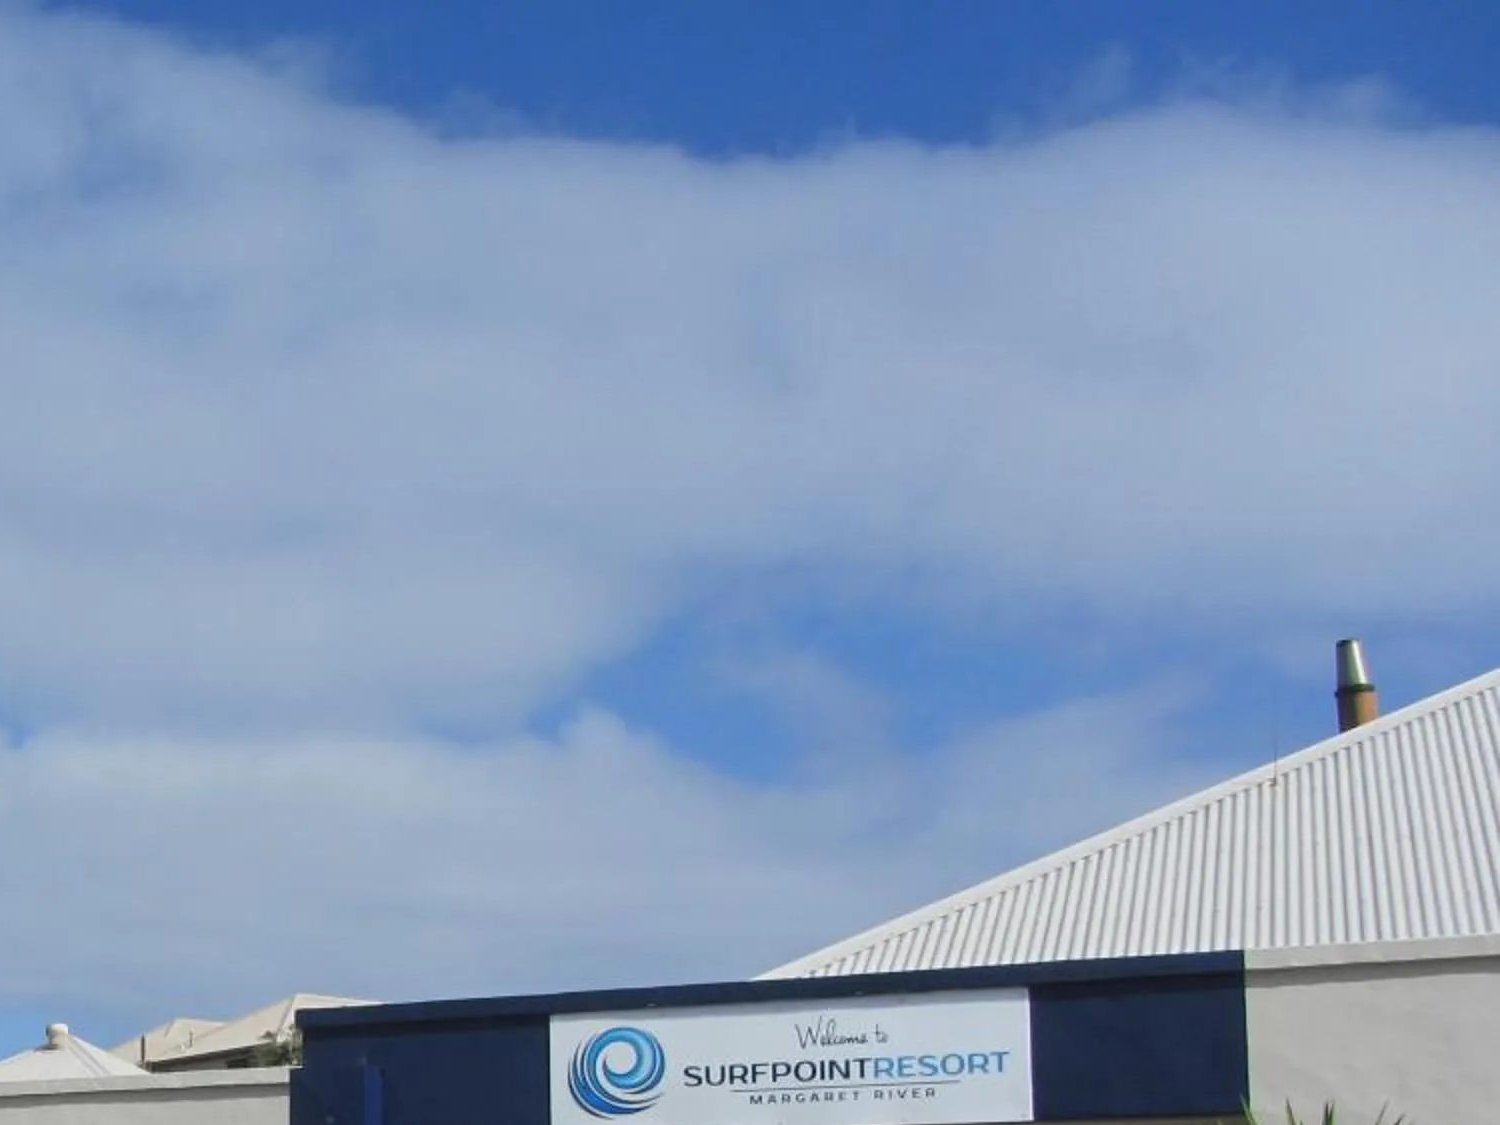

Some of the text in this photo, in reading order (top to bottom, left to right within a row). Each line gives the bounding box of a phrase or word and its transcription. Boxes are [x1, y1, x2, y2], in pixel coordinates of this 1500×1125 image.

[794, 1015, 890, 1049] Welcome to
[683, 1051, 1011, 1087] SURFPOINTRESORT
[749, 1087, 936, 1105] MARGARET RIVER
